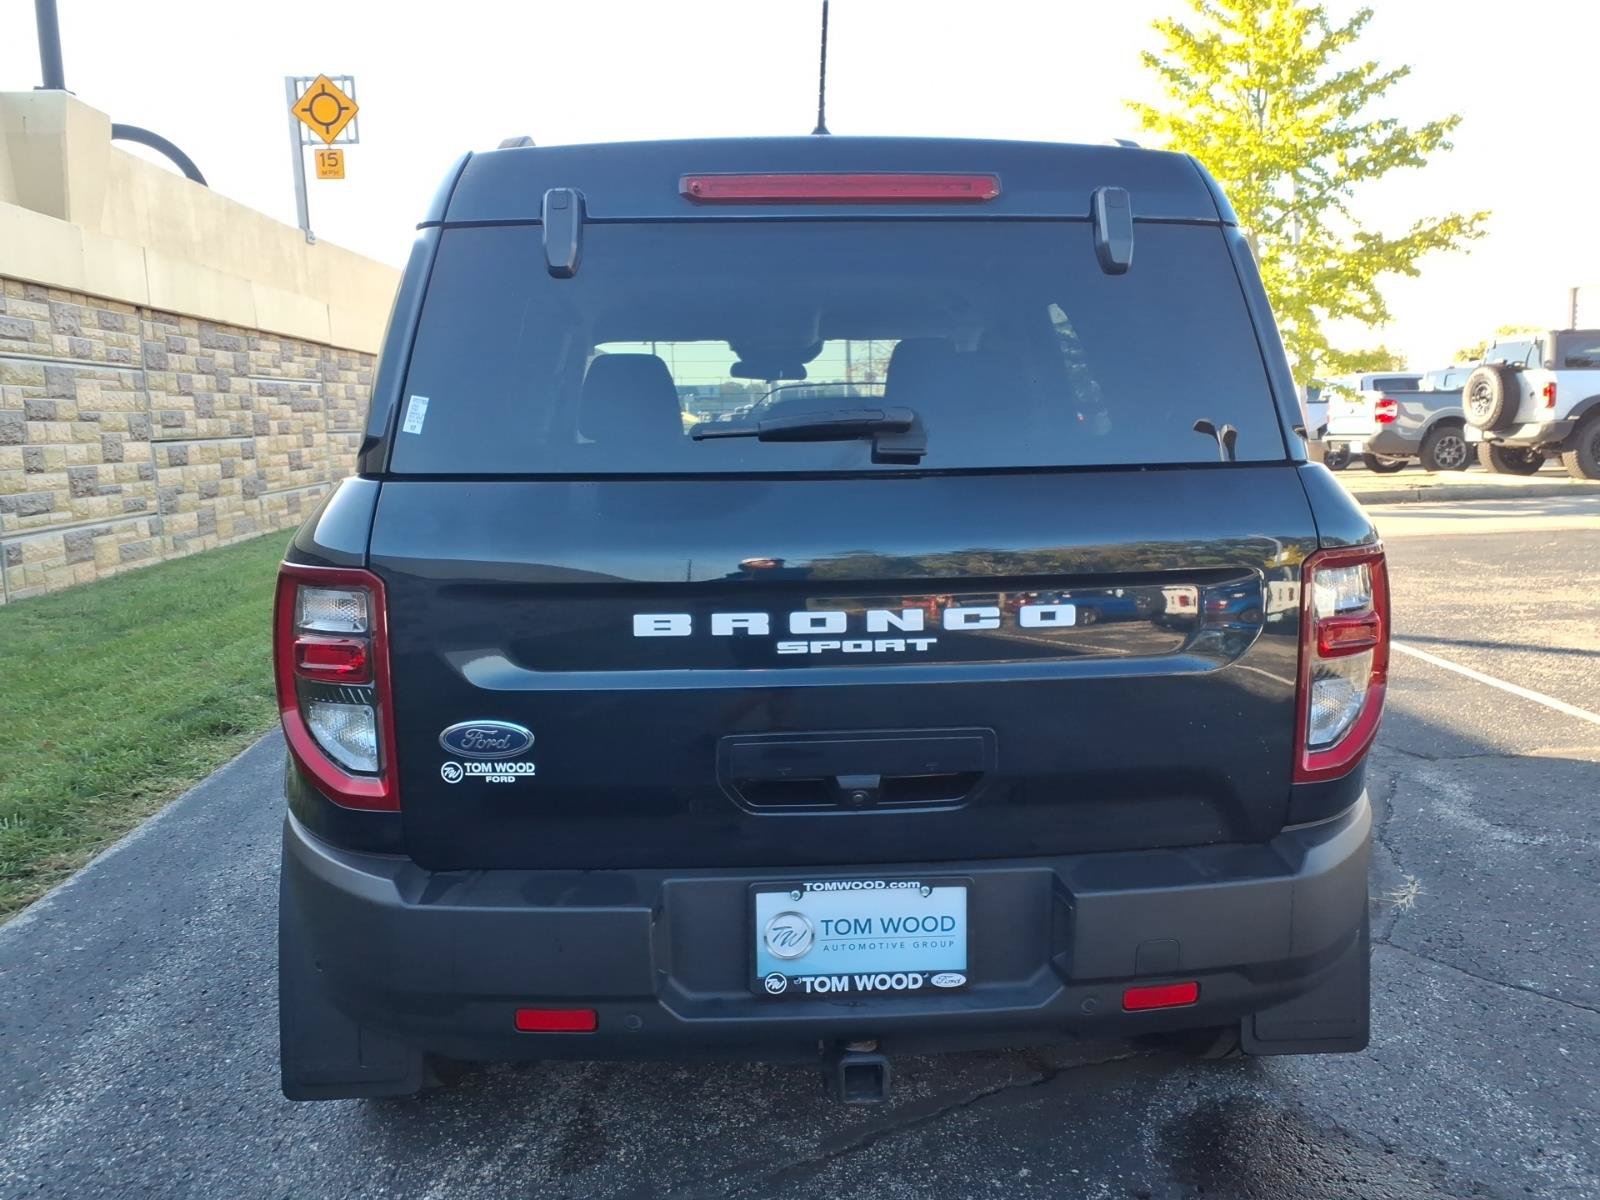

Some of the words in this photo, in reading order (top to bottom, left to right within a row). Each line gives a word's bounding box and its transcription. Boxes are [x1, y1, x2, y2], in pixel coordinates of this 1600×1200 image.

[320, 152, 338, 167] 15
[633, 604, 1076, 637] BRONCO
[776, 638, 937, 654] SPORT
[460, 728, 511, 749] Ford
[464, 762, 492, 773] TOM
[494, 762, 535, 773] WOOD
[485, 775, 516, 783] FORD
[803, 880, 920, 892] TOMWOOD.com
[821, 918, 872, 936] TOM
[880, 915, 956, 934] WOOD
[823, 941, 905, 952] AUTOMOTIVE
[912, 940, 954, 949] GROUP
[801, 975, 849, 993] TOM
[854, 973, 923, 991] WOOD
